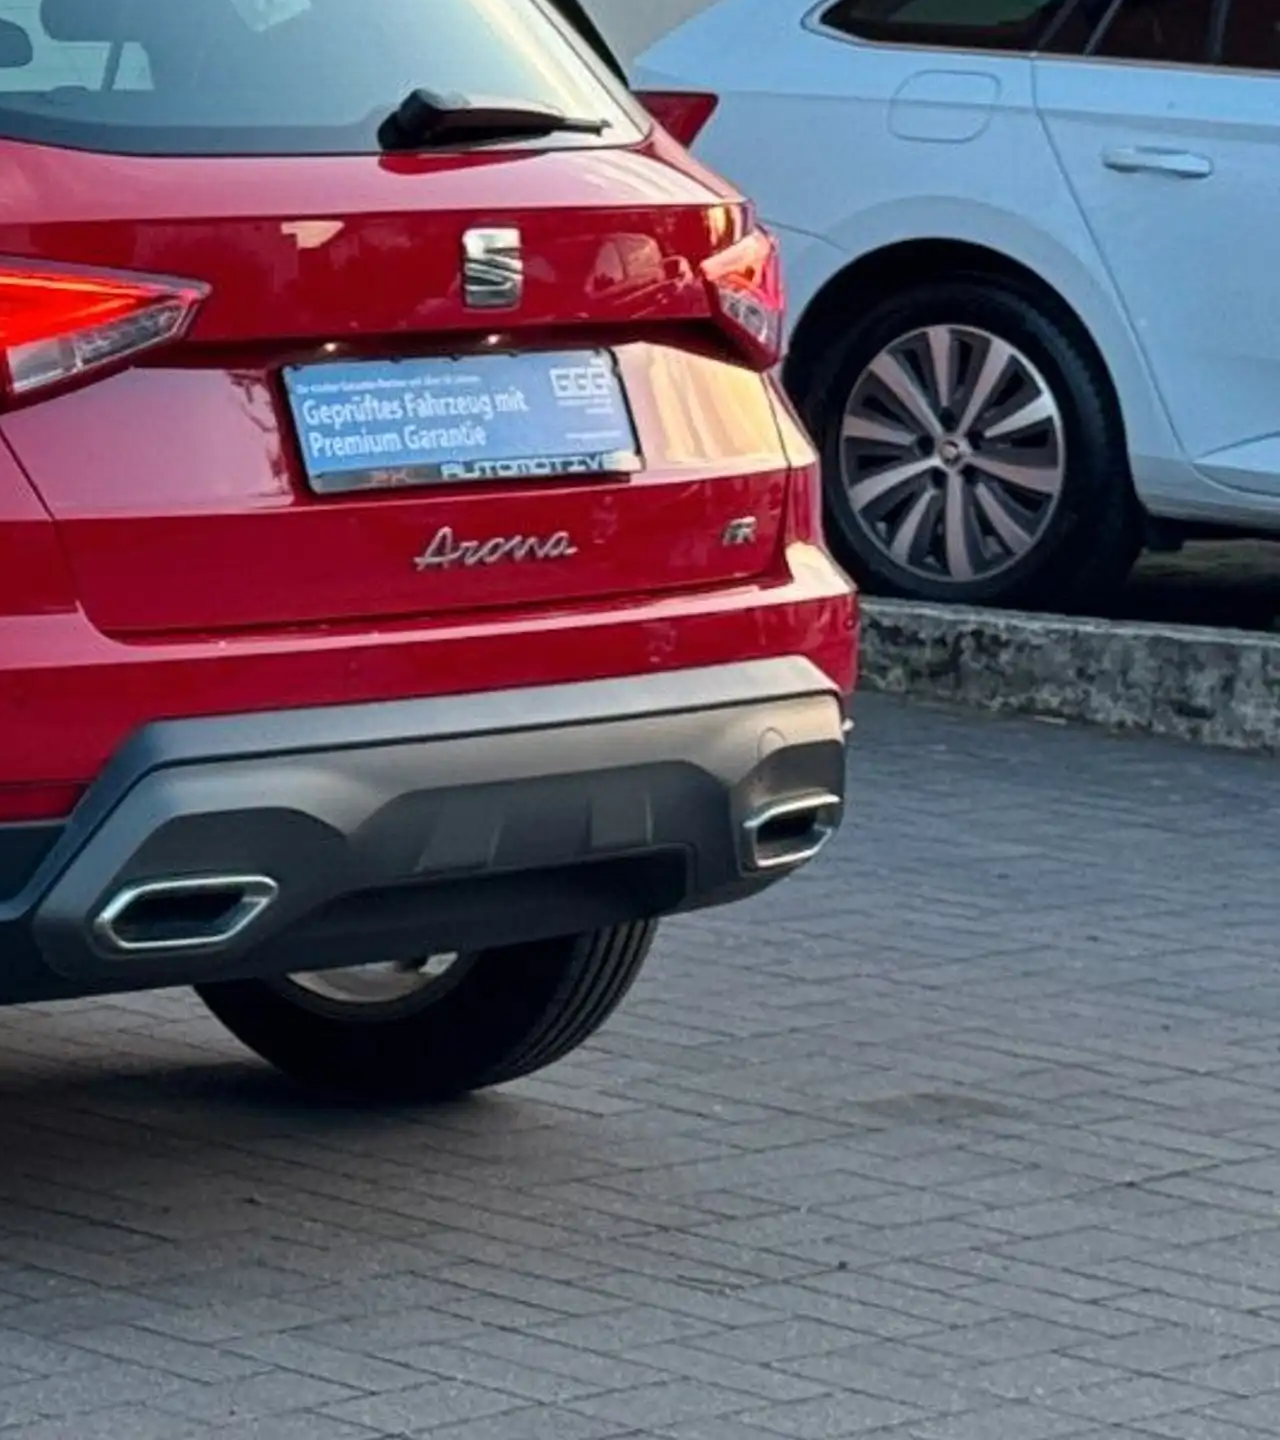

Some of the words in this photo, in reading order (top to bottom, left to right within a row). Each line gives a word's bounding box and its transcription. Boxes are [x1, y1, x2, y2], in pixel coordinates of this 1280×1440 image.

[302, 393, 403, 430] Geprüftes
[403, 391, 494, 421] Fahrzeug
[494, 385, 531, 413] mit
[308, 426, 403, 459] Premium
[403, 420, 487, 450] Garantie
[413, 525, 578, 571] Arona
